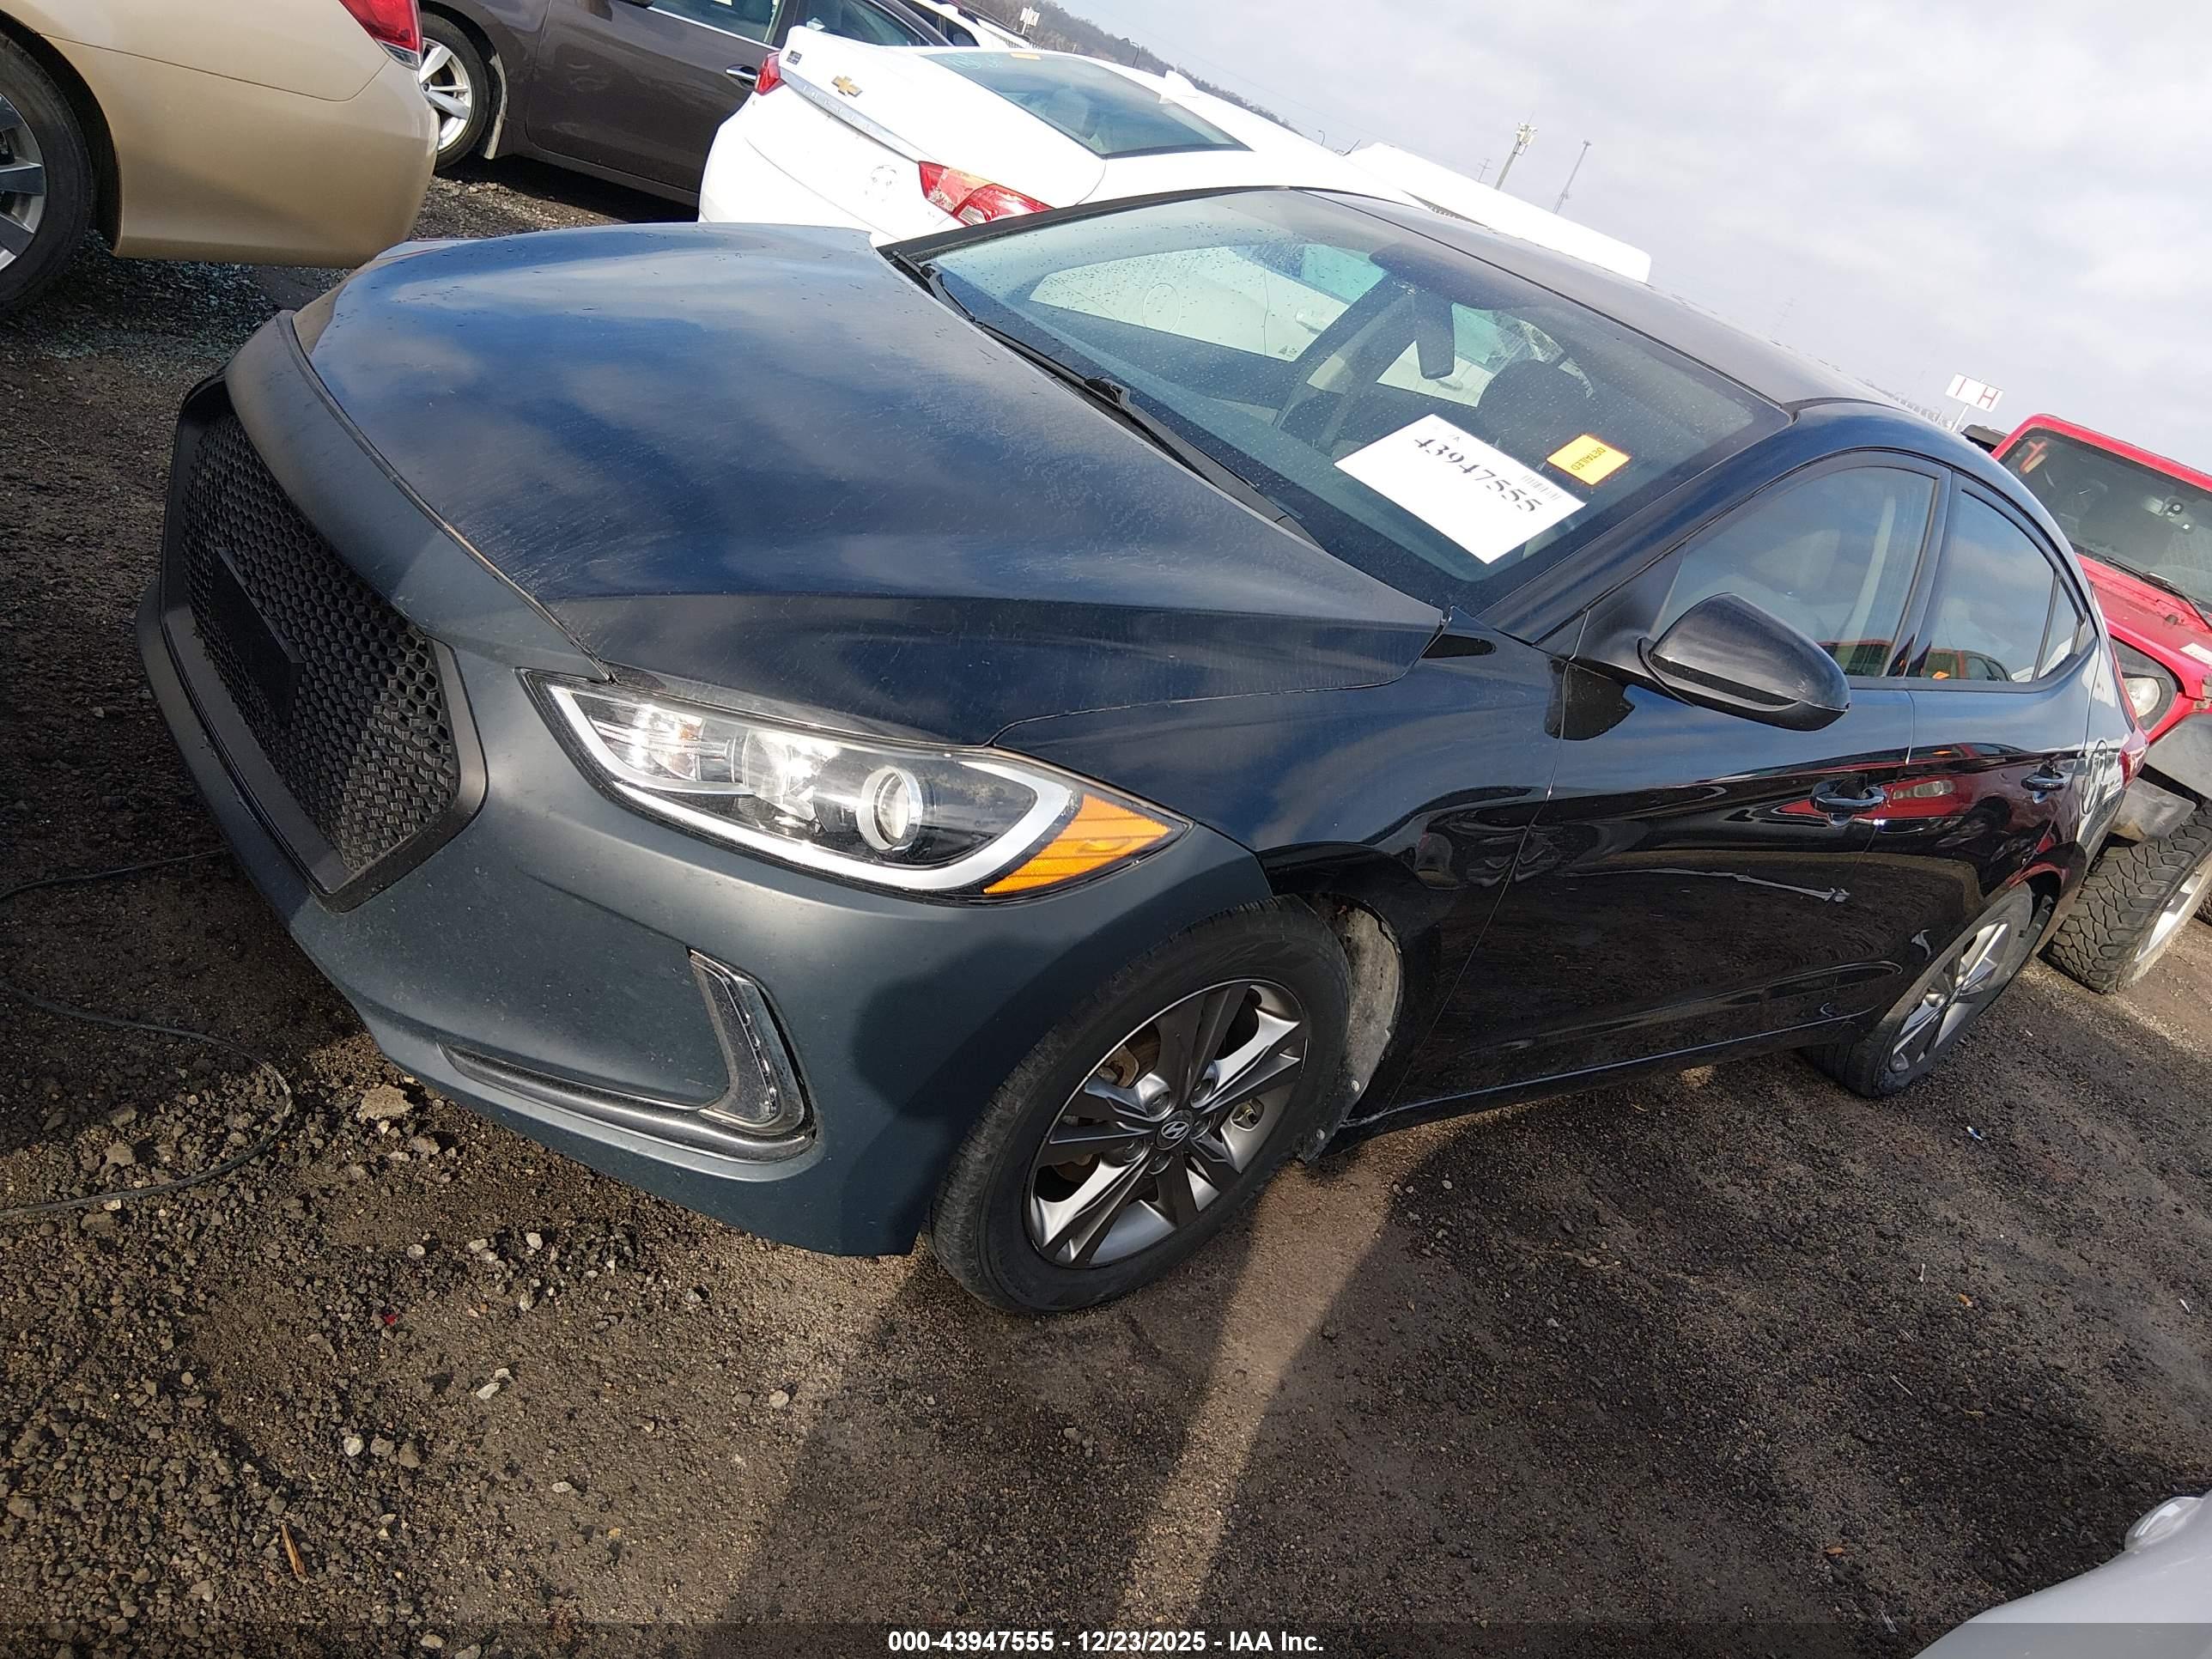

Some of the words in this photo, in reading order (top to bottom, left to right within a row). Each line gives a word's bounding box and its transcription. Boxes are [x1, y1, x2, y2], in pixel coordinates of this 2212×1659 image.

[1977, 386, 1999, 409] H
[1570, 447, 1607, 471] DETAILED
[1413, 438, 1543, 512] 43947555
